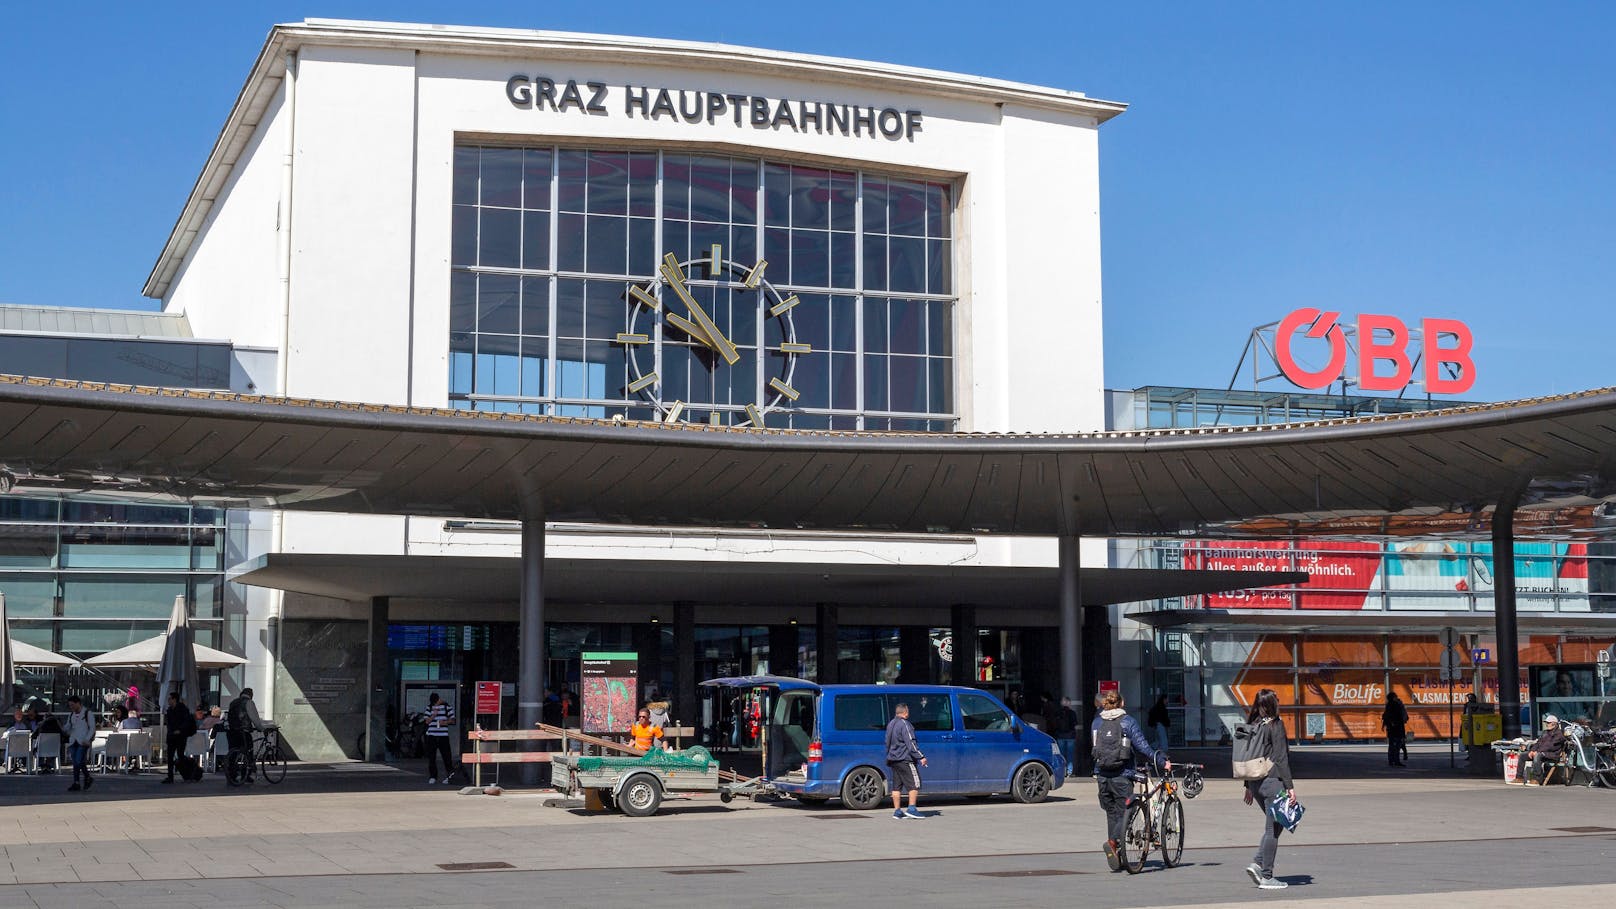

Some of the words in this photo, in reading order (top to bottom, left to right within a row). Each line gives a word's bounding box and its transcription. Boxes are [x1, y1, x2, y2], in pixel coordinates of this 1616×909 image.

[506, 75, 607, 113] GRAZ
[625, 85, 923, 141] HAUPTBAHNHOF
[1274, 307, 1477, 395] ÖBB
[1205, 546, 1323, 561] Bahnhofswerung.
[1206, 561, 1236, 571] Alles
[1281, 564, 1356, 576] gwöhnlich.
[1333, 682, 1382, 704] BioLife
